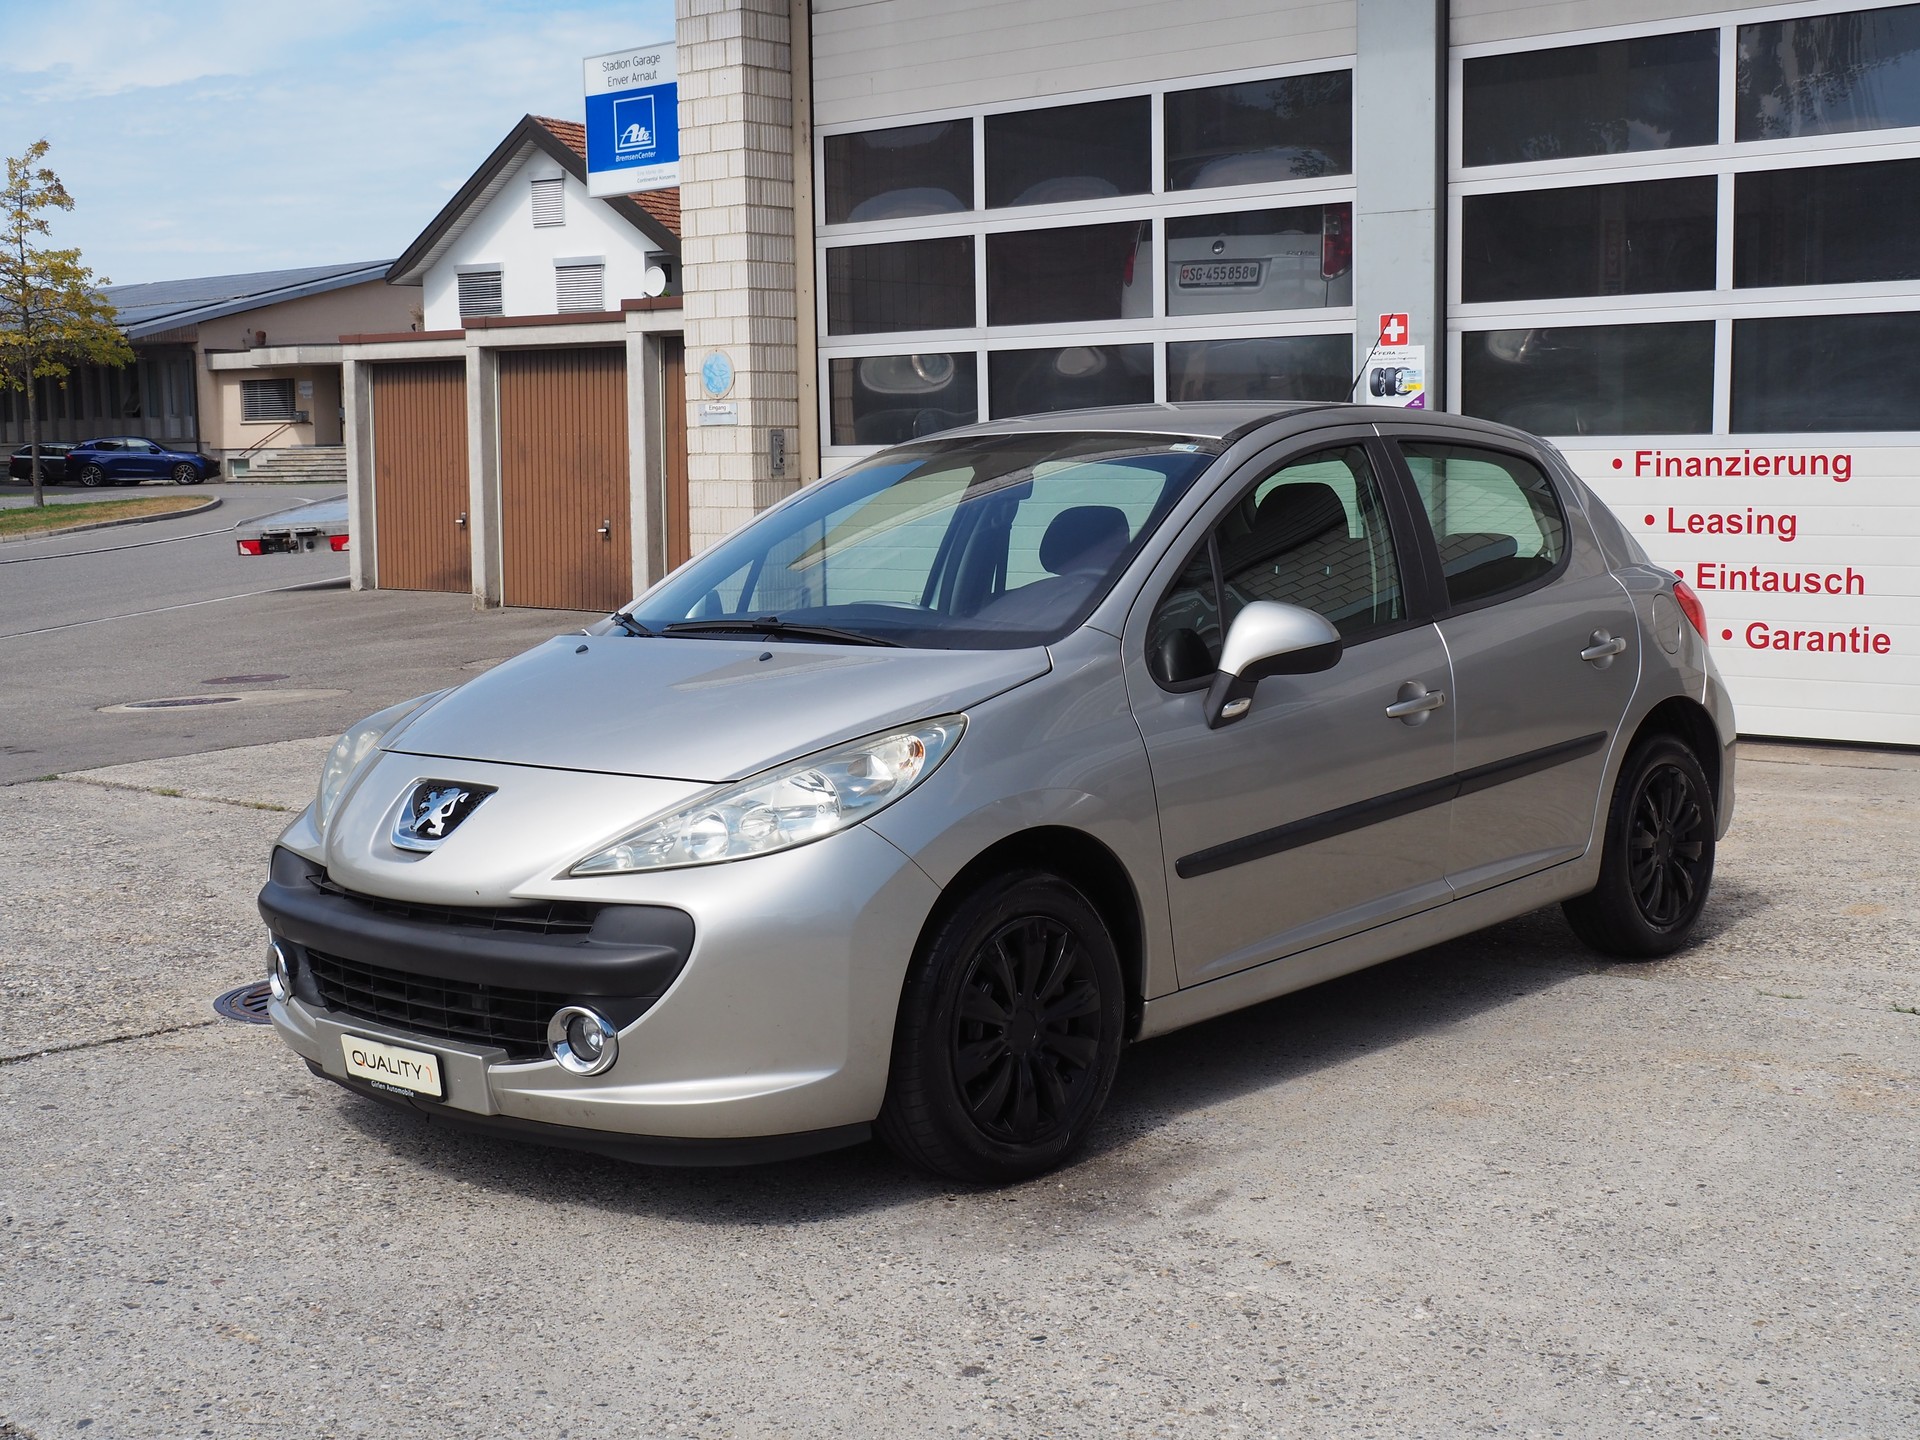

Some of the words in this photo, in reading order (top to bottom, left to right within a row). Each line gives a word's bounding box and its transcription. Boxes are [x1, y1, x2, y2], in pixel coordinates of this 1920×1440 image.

[602, 58, 631, 72] Stadion
[633, 54, 660, 67] Garage
[608, 76, 629, 87] Enver
[632, 70, 657, 83] Arnaut
[616, 151, 656, 162] BremsenCenter
[1636, 450, 1851, 482] Finanzierung
[1668, 508, 1796, 542] Leasing
[1697, 563, 1864, 595] Eintausch
[1746, 622, 1891, 654] Garantie
[387, 1085, 414, 1097] Automobile
